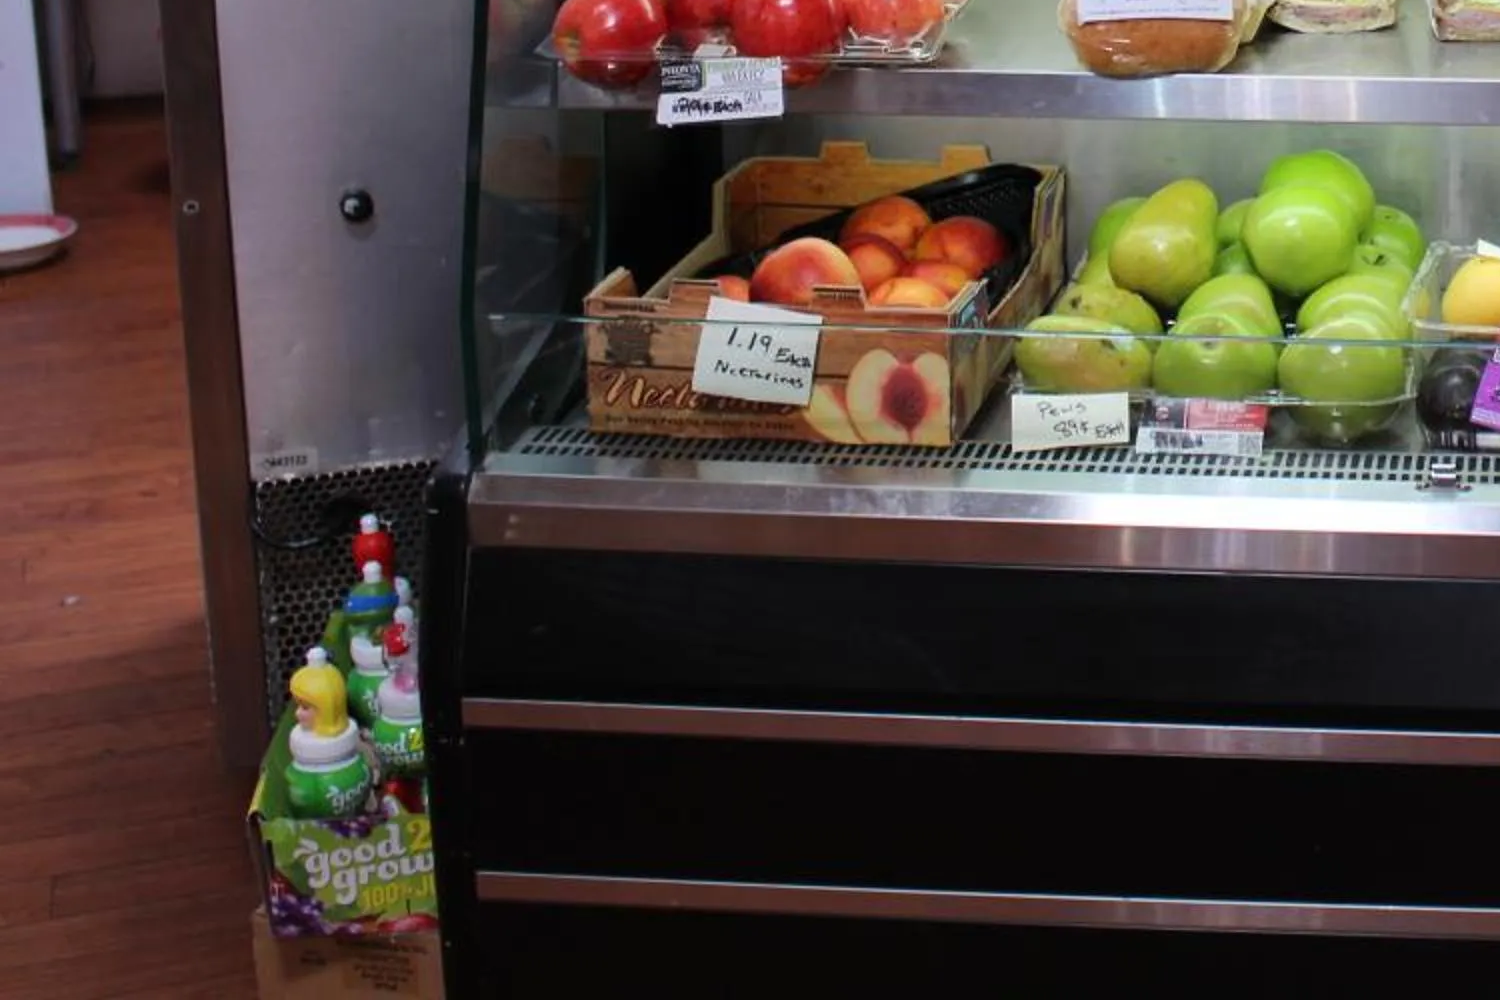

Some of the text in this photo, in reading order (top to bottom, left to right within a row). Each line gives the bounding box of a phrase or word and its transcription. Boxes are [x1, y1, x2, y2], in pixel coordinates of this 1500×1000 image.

[305, 824, 406, 889] good
[407, 820, 431, 853] 2
[332, 853, 434, 905] grow
